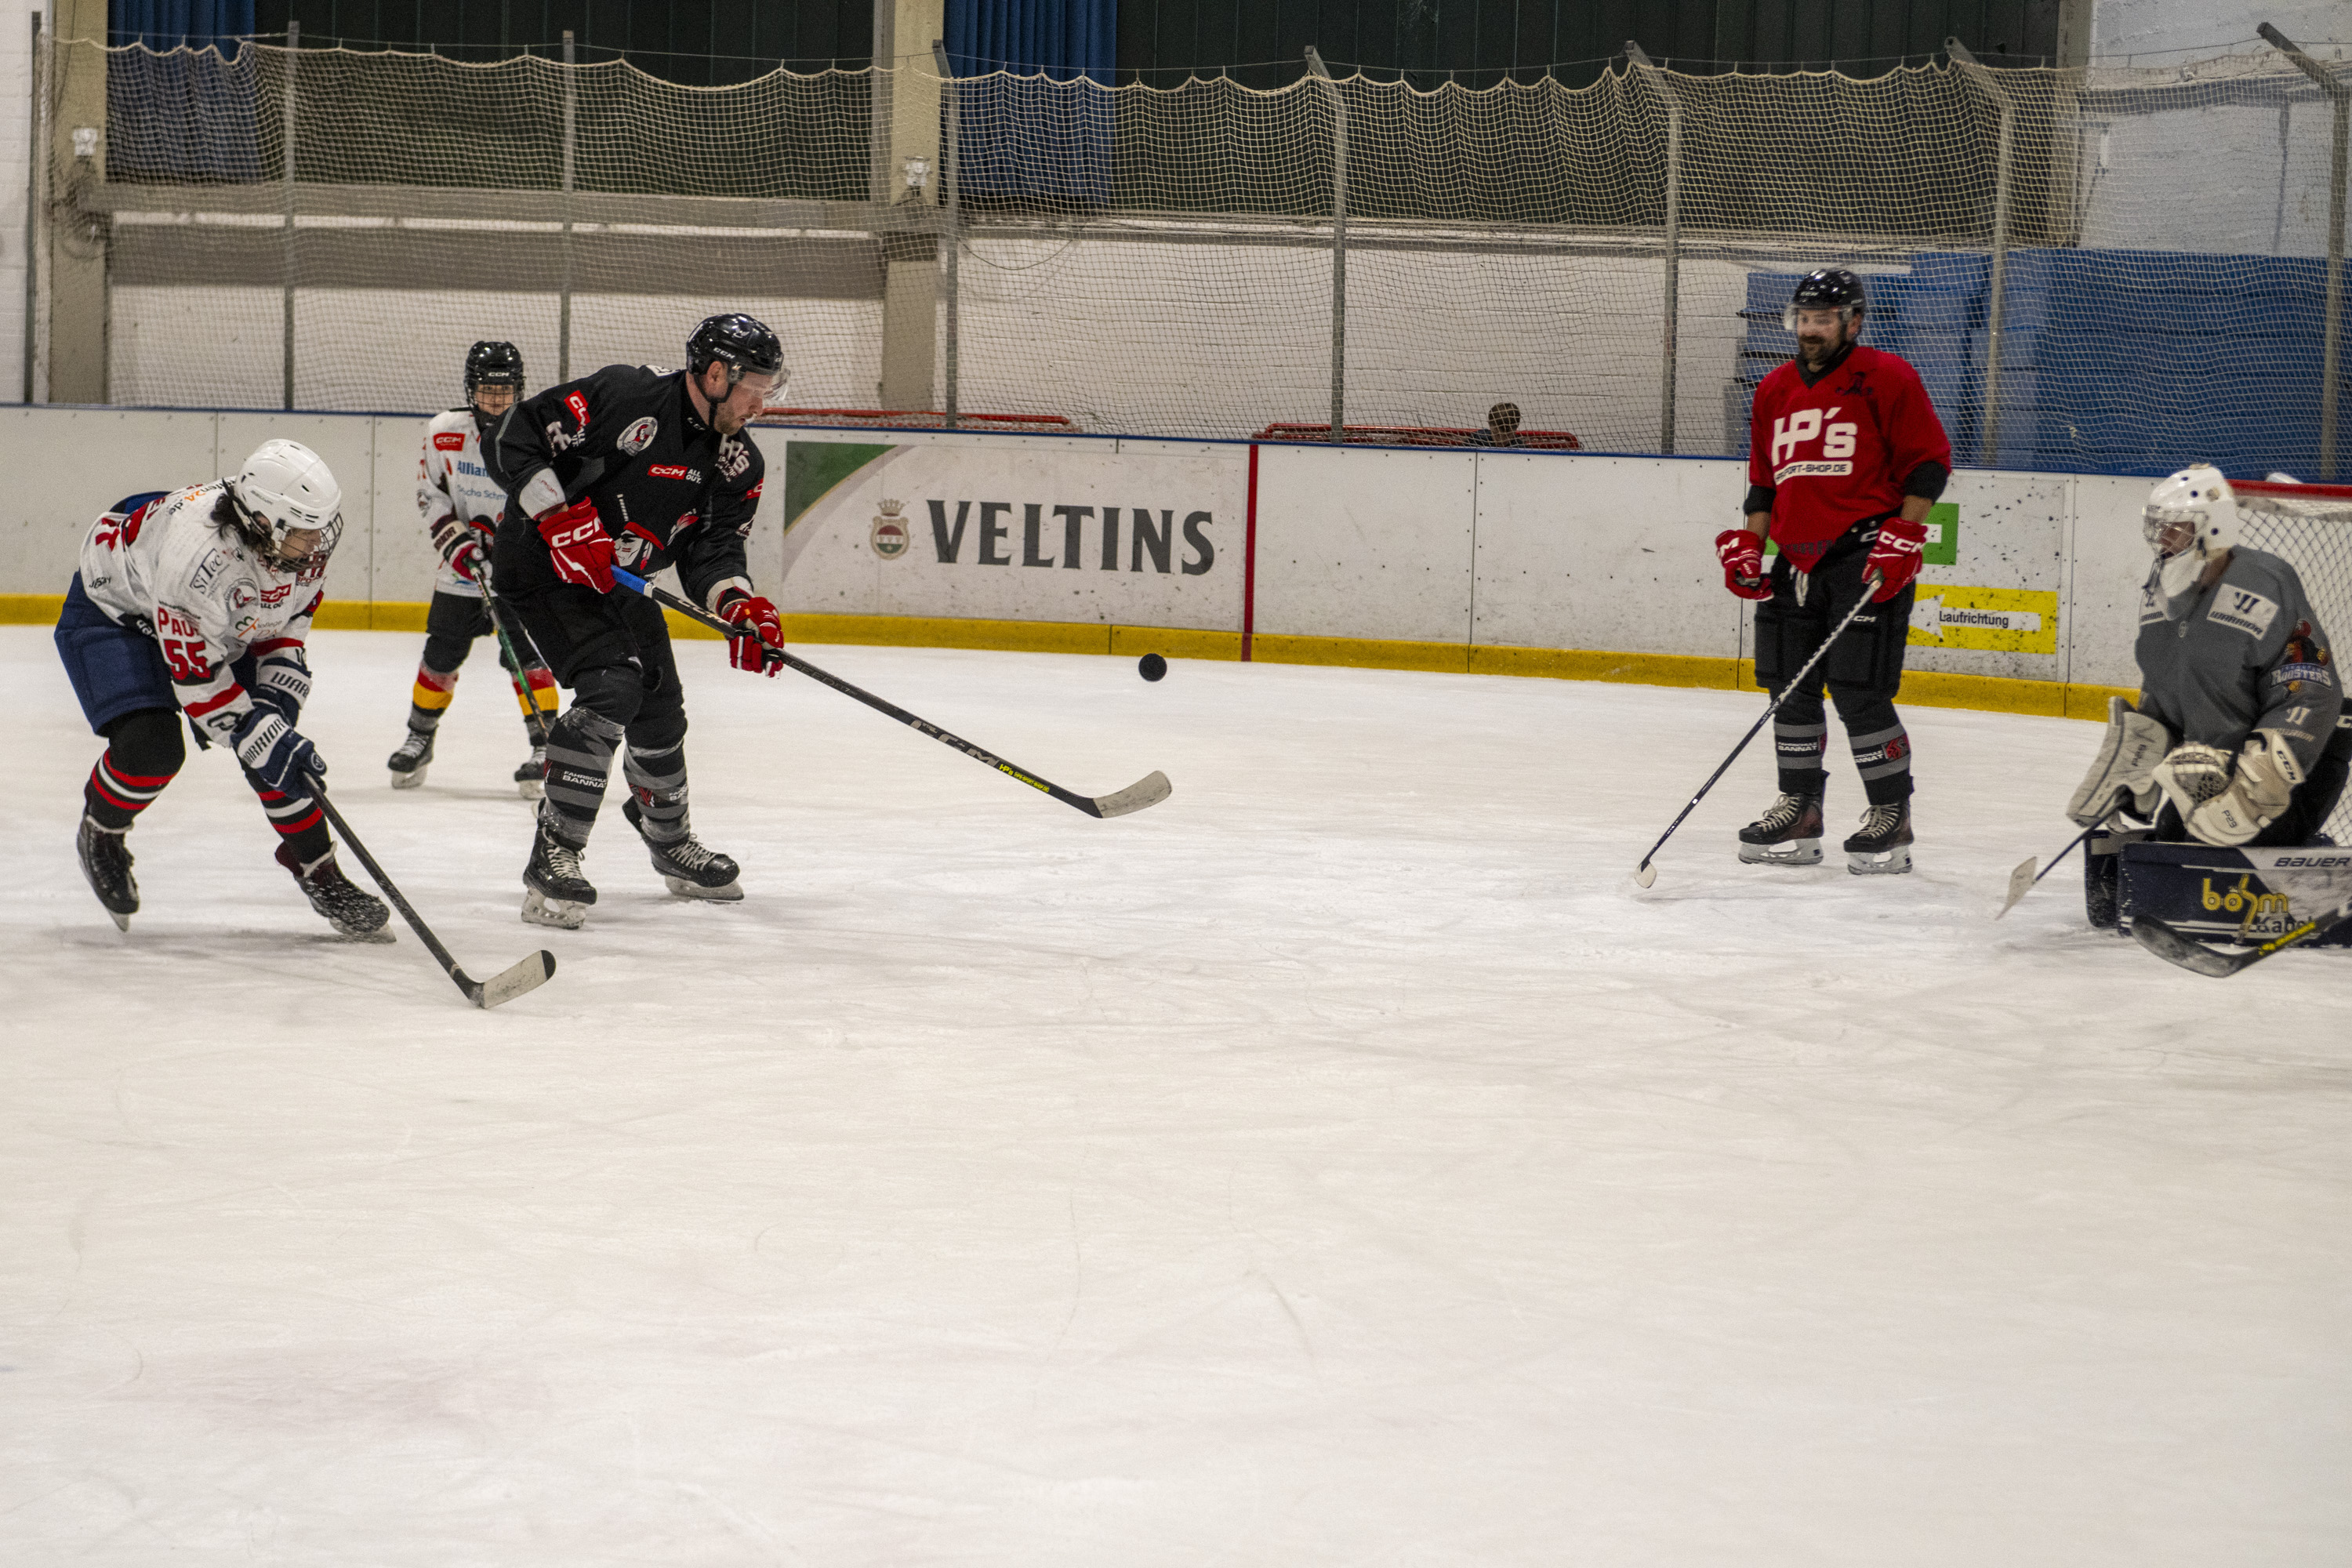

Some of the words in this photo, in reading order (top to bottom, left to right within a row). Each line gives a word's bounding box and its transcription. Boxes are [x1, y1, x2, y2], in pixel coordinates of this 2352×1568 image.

[713, 347, 735, 359] CCM
[651, 466, 686, 477] CCM
[688, 468, 701, 477] ALL
[926, 499, 1215, 576] VELTINS
[1939, 610, 2009, 629] Laufrichtung
[2209, 610, 2263, 635] WARRIOR
[164, 638, 211, 681] 55
[2270, 668, 2332, 688] ROOSTERS
[909, 719, 1001, 768] CCM
[2275, 750, 2297, 781] CCM
[2274, 856, 2351, 868] BAUER
